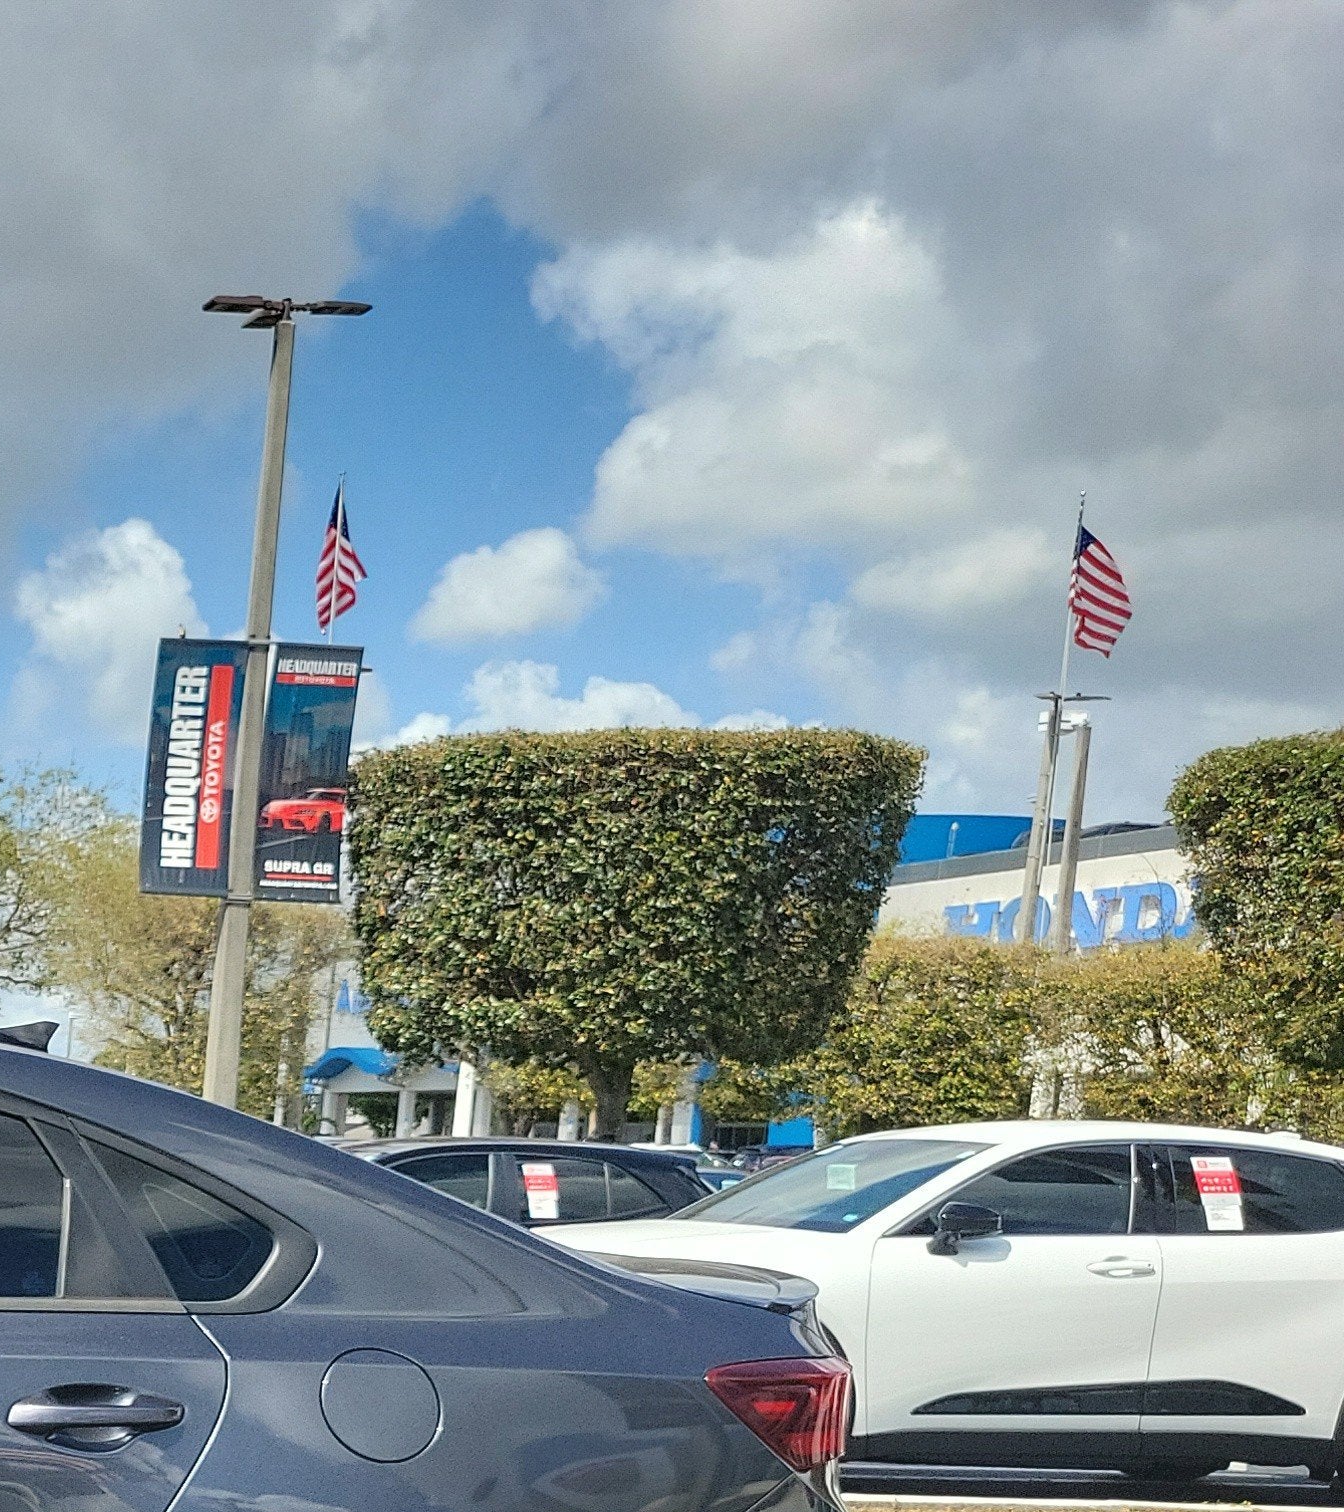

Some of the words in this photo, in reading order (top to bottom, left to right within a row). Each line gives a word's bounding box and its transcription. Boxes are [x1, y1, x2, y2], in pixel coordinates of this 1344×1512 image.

[277, 658, 358, 677] HEADQUARTER
[159, 664, 211, 869] HEADQUARTER
[203, 720, 226, 799] TOYOTA
[264, 859, 311, 874] SUPRA
[944, 876, 1201, 949] HOND
